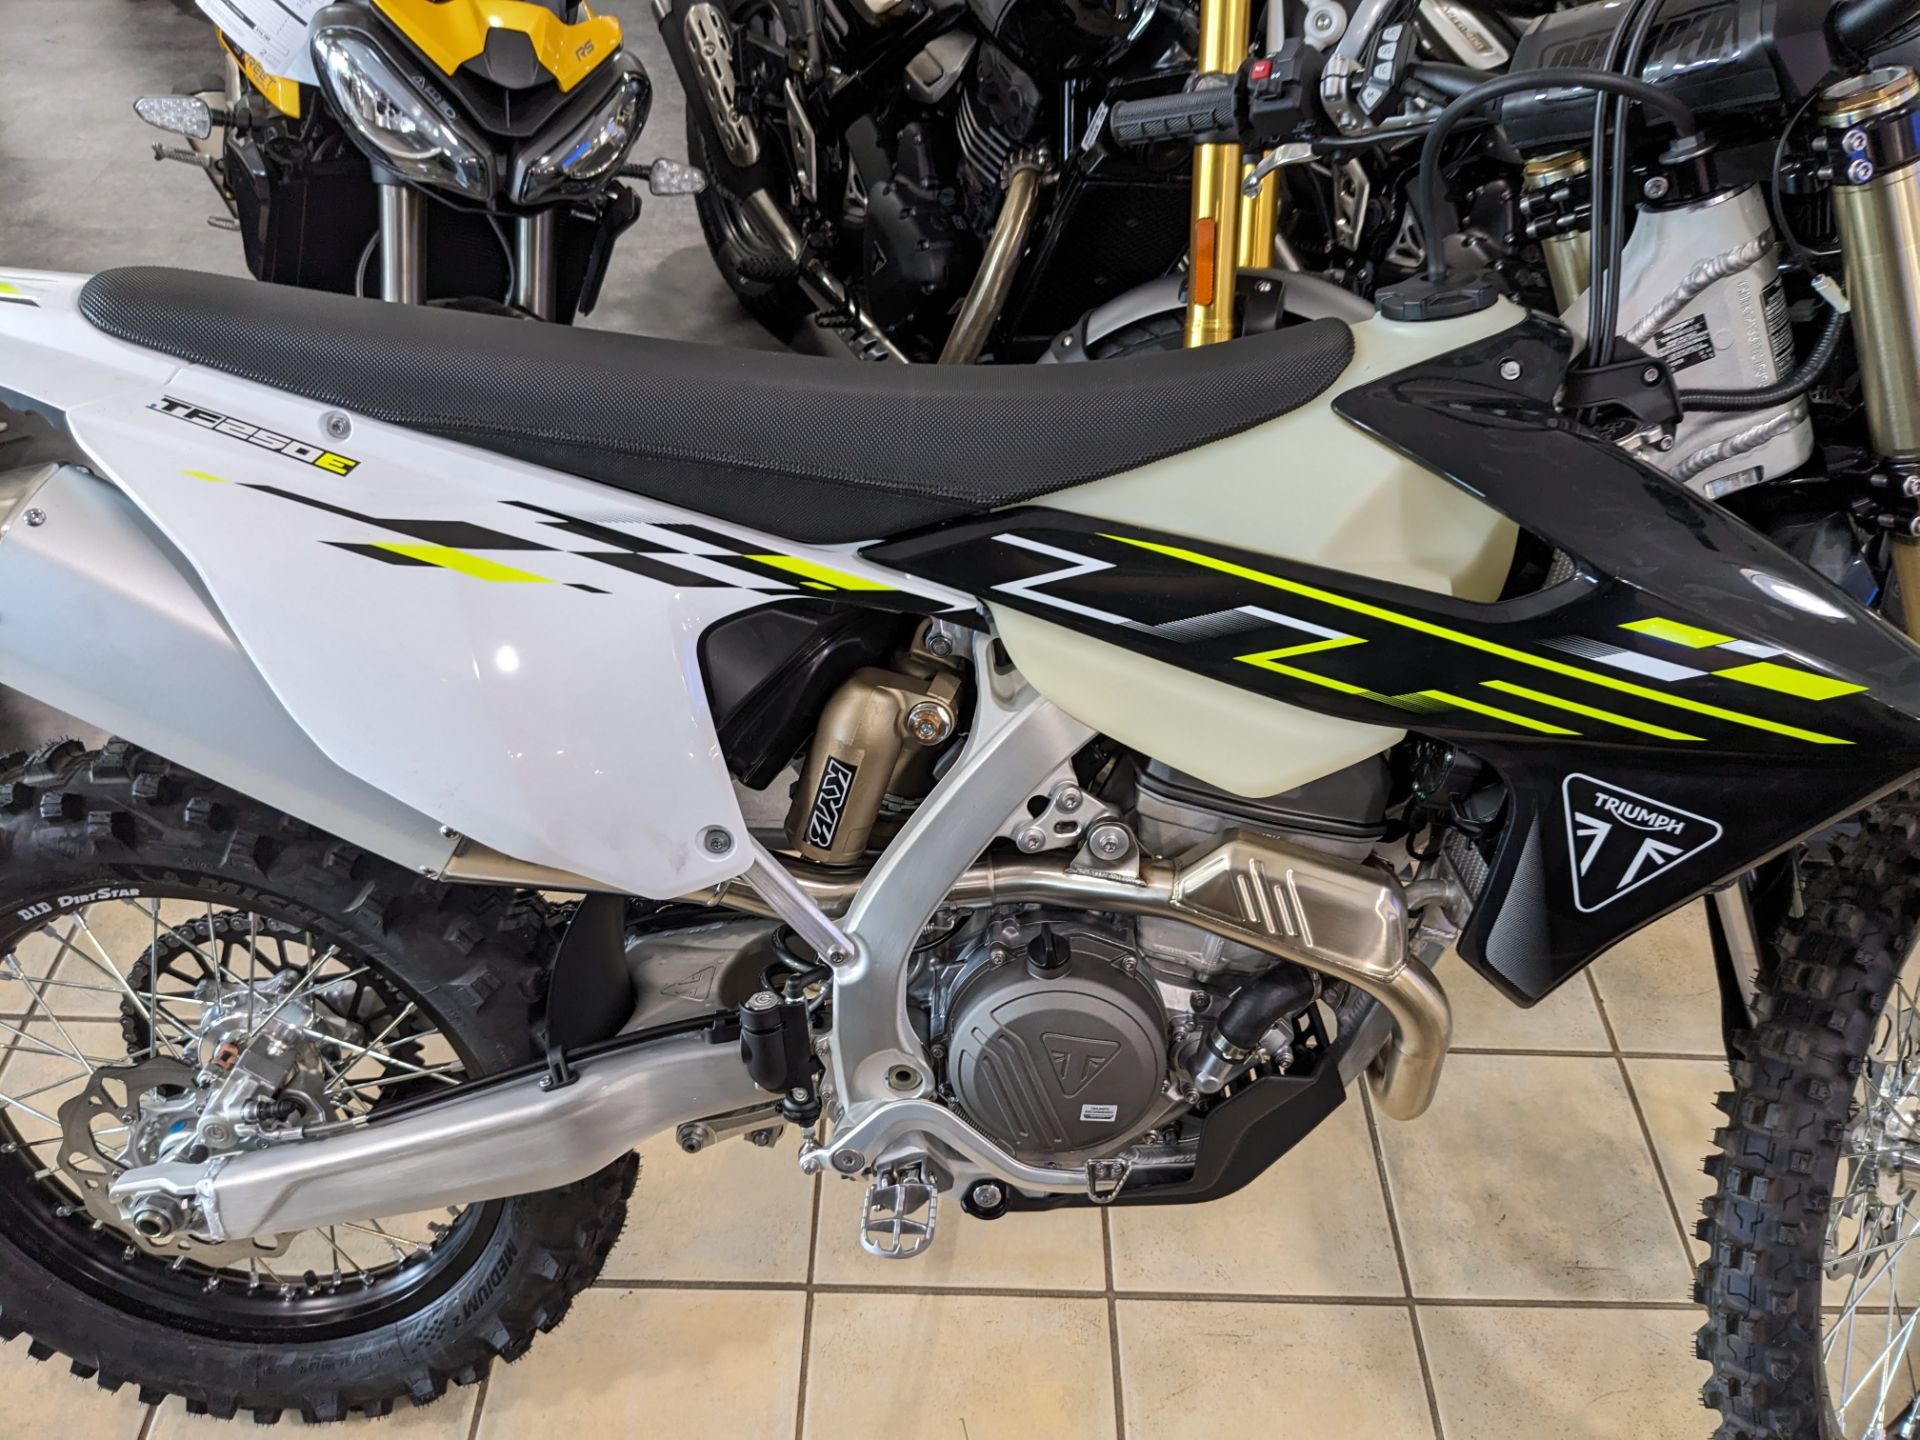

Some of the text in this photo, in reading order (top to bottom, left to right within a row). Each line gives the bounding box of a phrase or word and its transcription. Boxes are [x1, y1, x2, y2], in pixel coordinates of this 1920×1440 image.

[575, 39, 595, 62] RS
[160, 396, 361, 477] TF250E
[808, 759, 853, 848] KYB
[1594, 792, 1686, 835] TRIUMPH
[462, 1238, 519, 1320] MEDIUM
